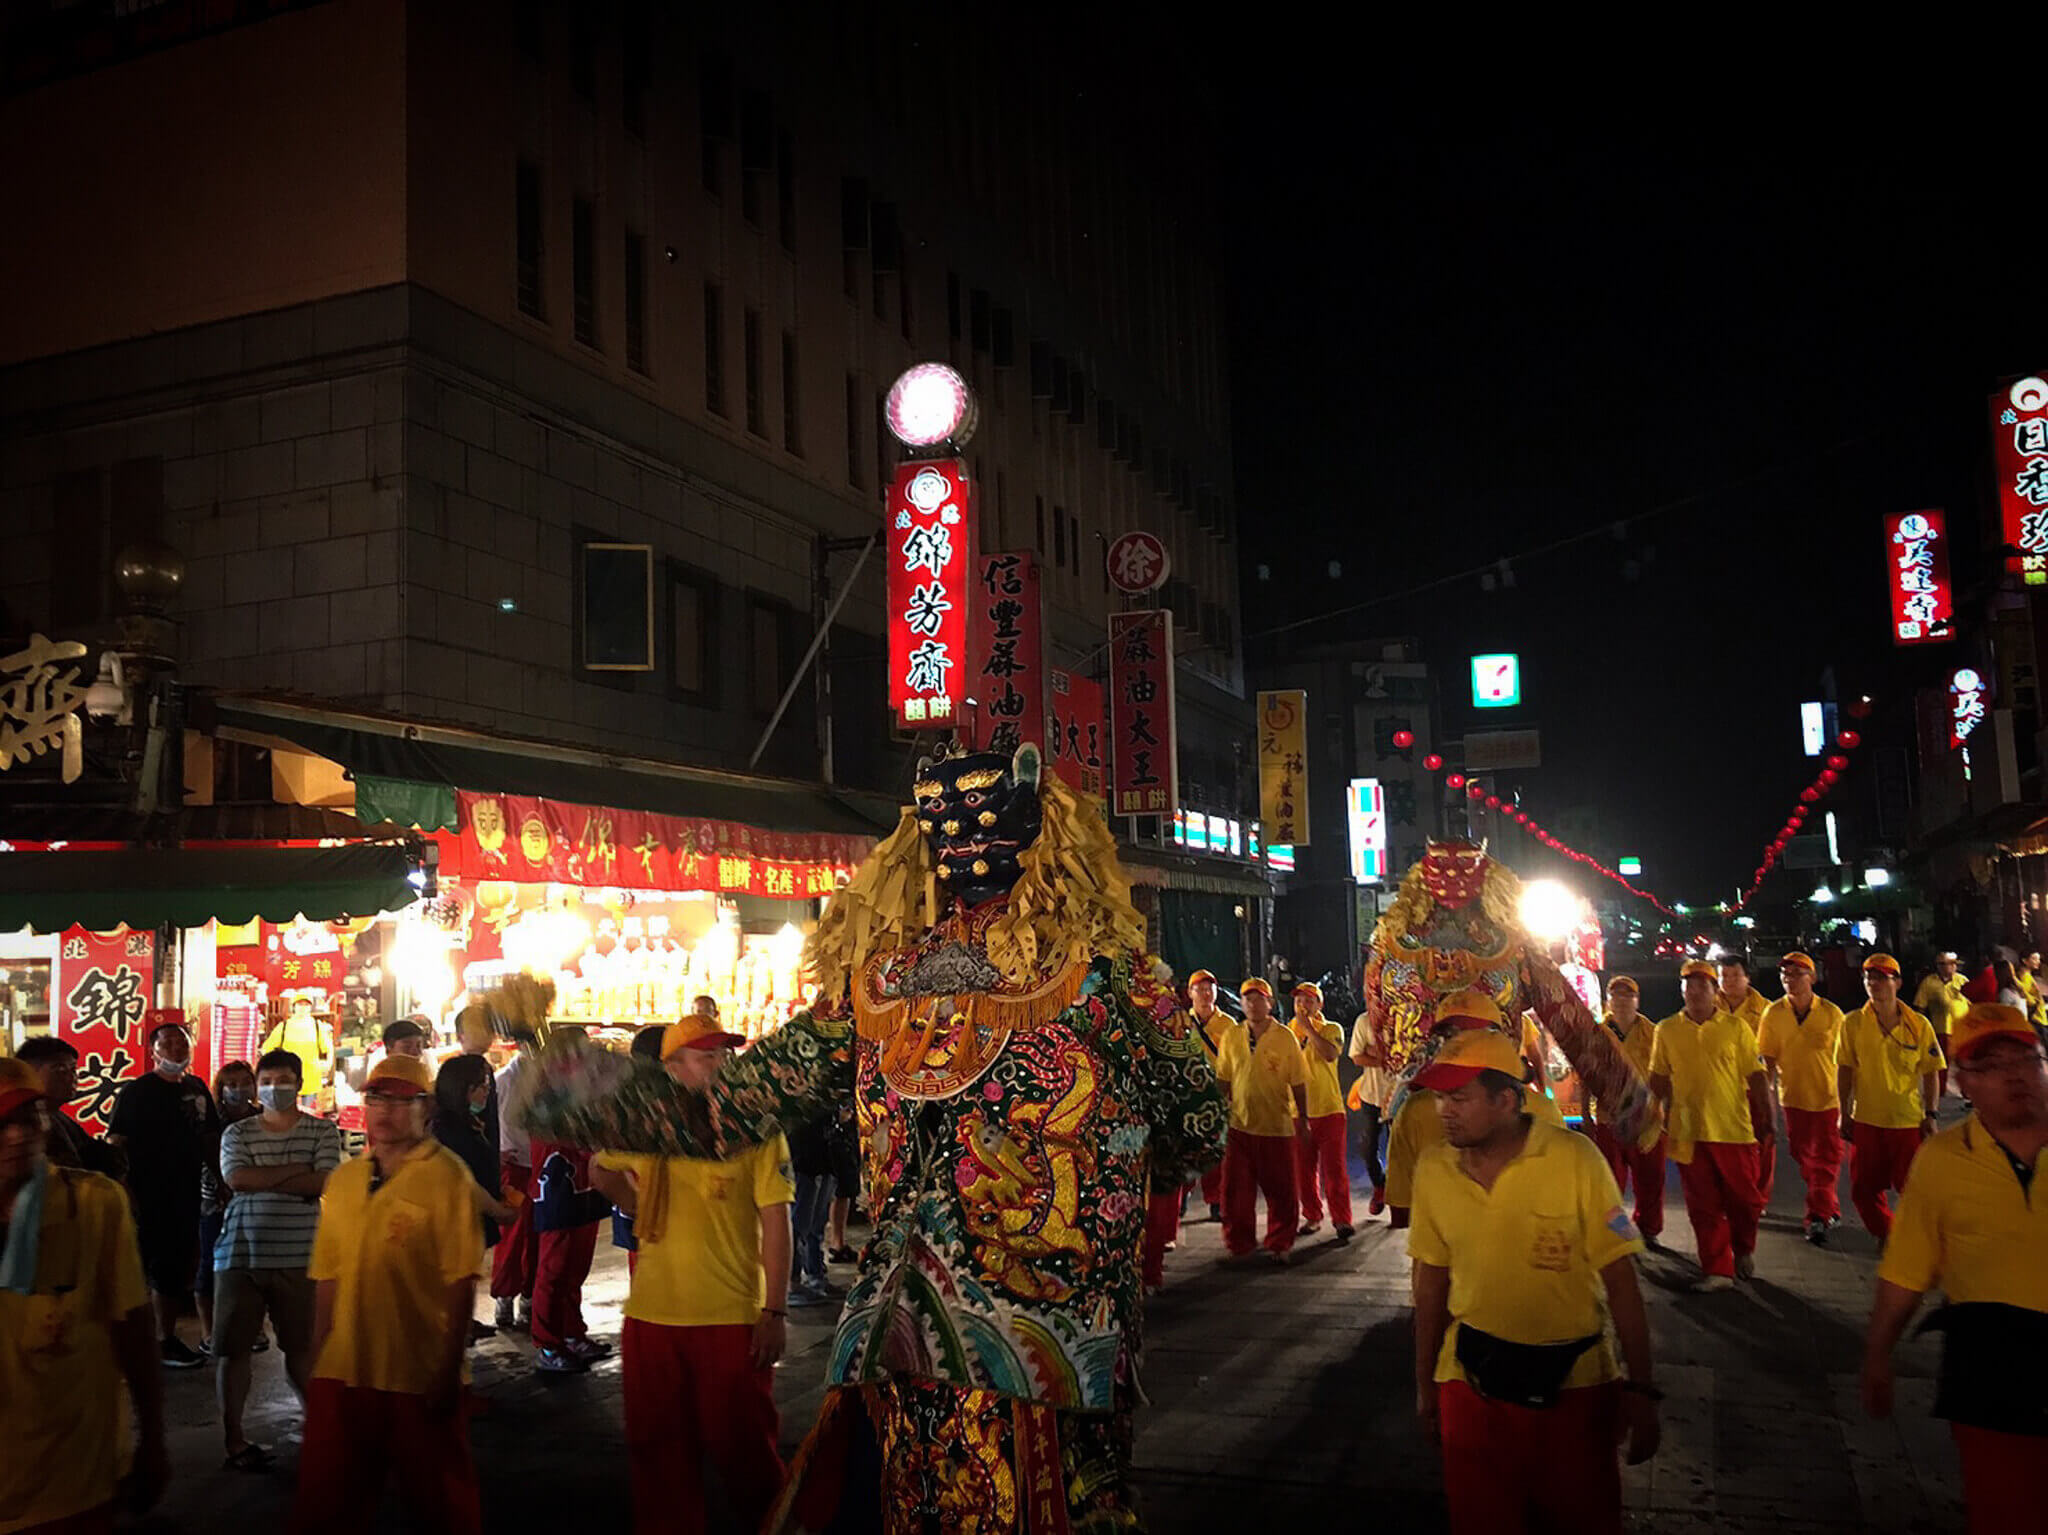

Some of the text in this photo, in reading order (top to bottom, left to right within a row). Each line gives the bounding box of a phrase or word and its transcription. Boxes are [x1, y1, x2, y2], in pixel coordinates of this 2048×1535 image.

[1116, 539, 1160, 584] 徐
[902, 525, 954, 694] 錦芳齋
[904, 695, 952, 721] 囍餅
[63, 934, 152, 960] 北港
